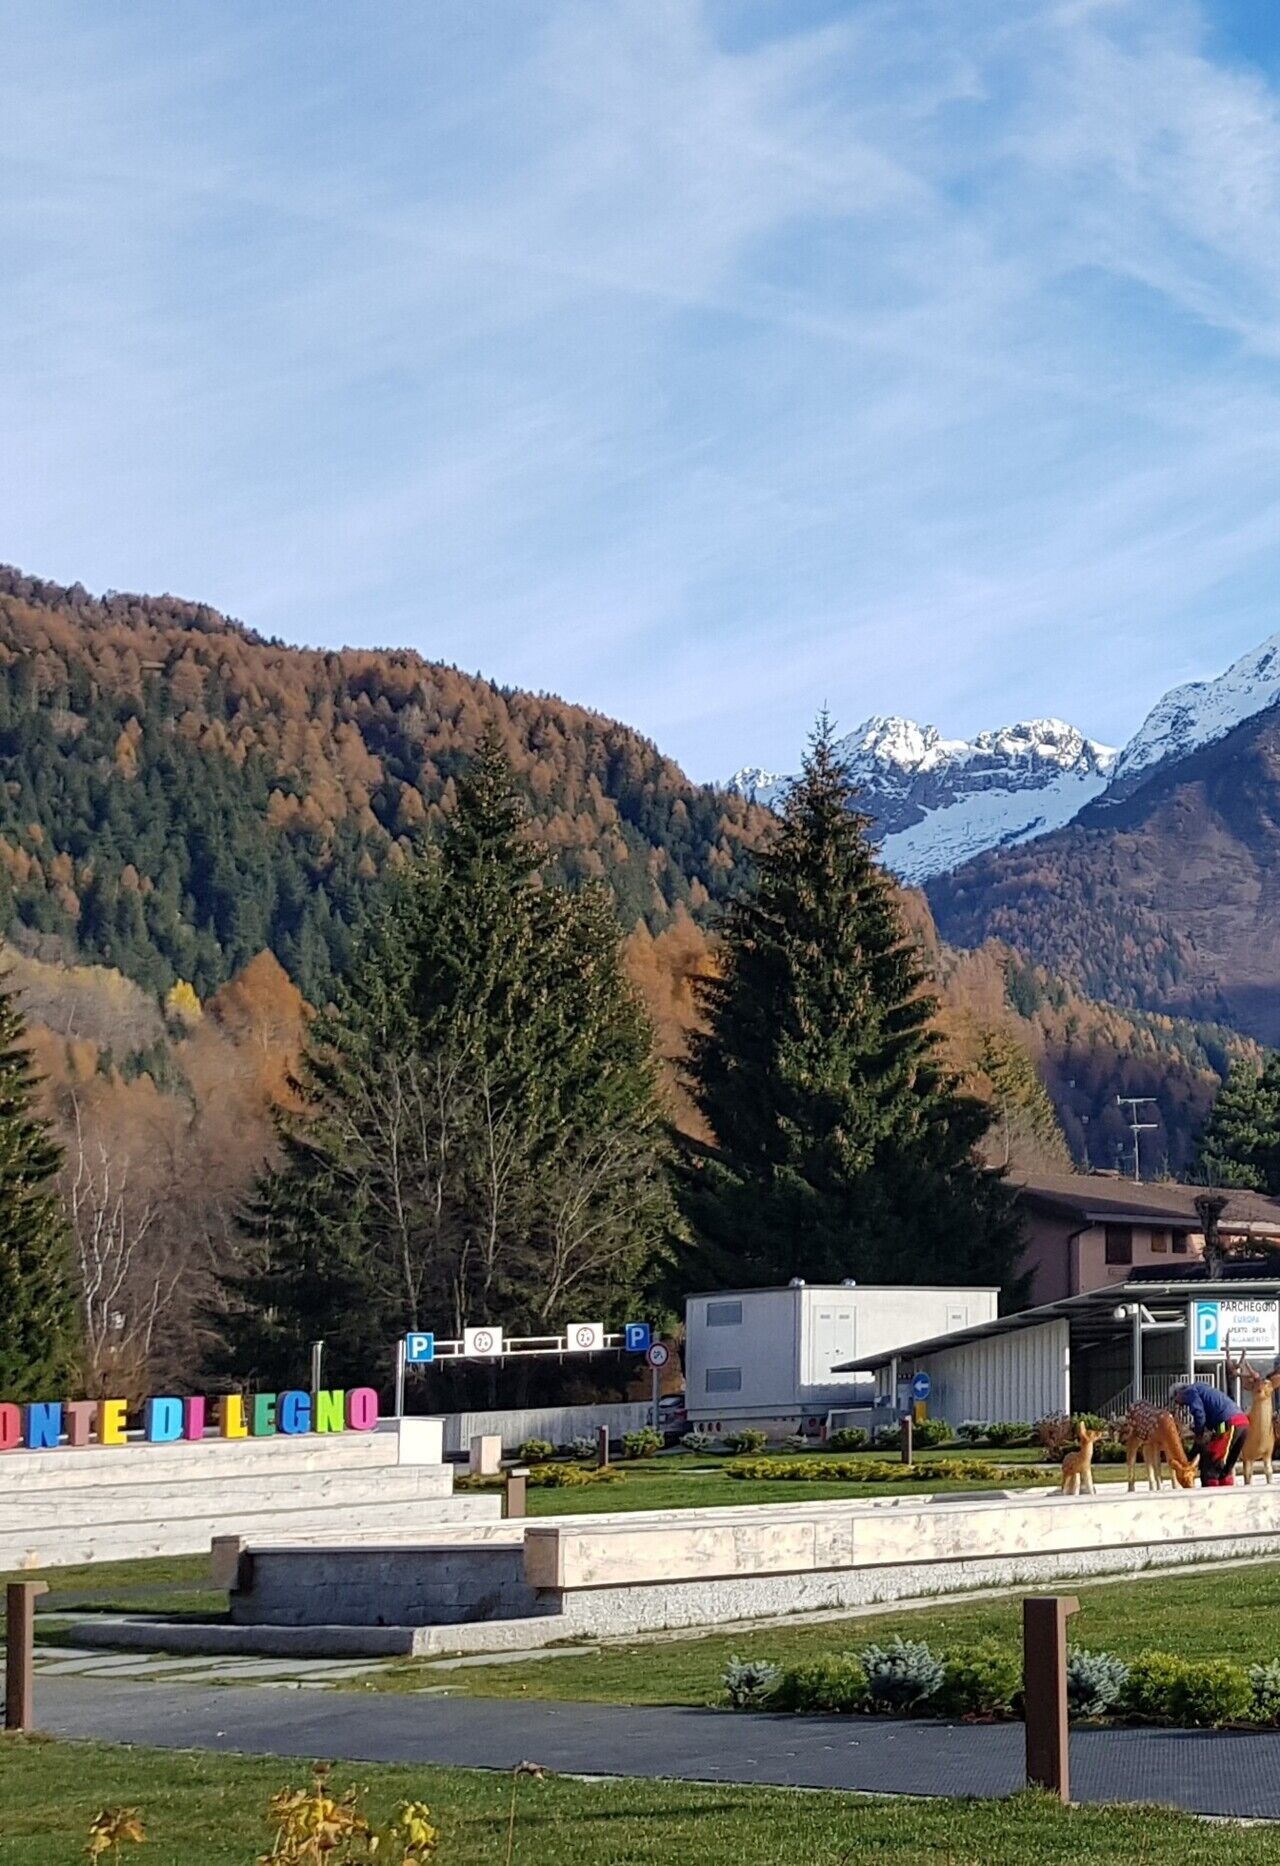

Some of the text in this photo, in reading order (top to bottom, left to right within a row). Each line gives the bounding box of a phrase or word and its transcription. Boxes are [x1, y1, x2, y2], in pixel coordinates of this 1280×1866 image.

[1220, 1301, 1277, 1312] PARCHEGGIO
[631, 1327, 645, 1347] P
[1200, 1313, 1217, 1347] P
[412, 1336, 428, 1358] P
[147, 1395, 206, 1443] DI
[220, 1386, 378, 1439] LEGNO
